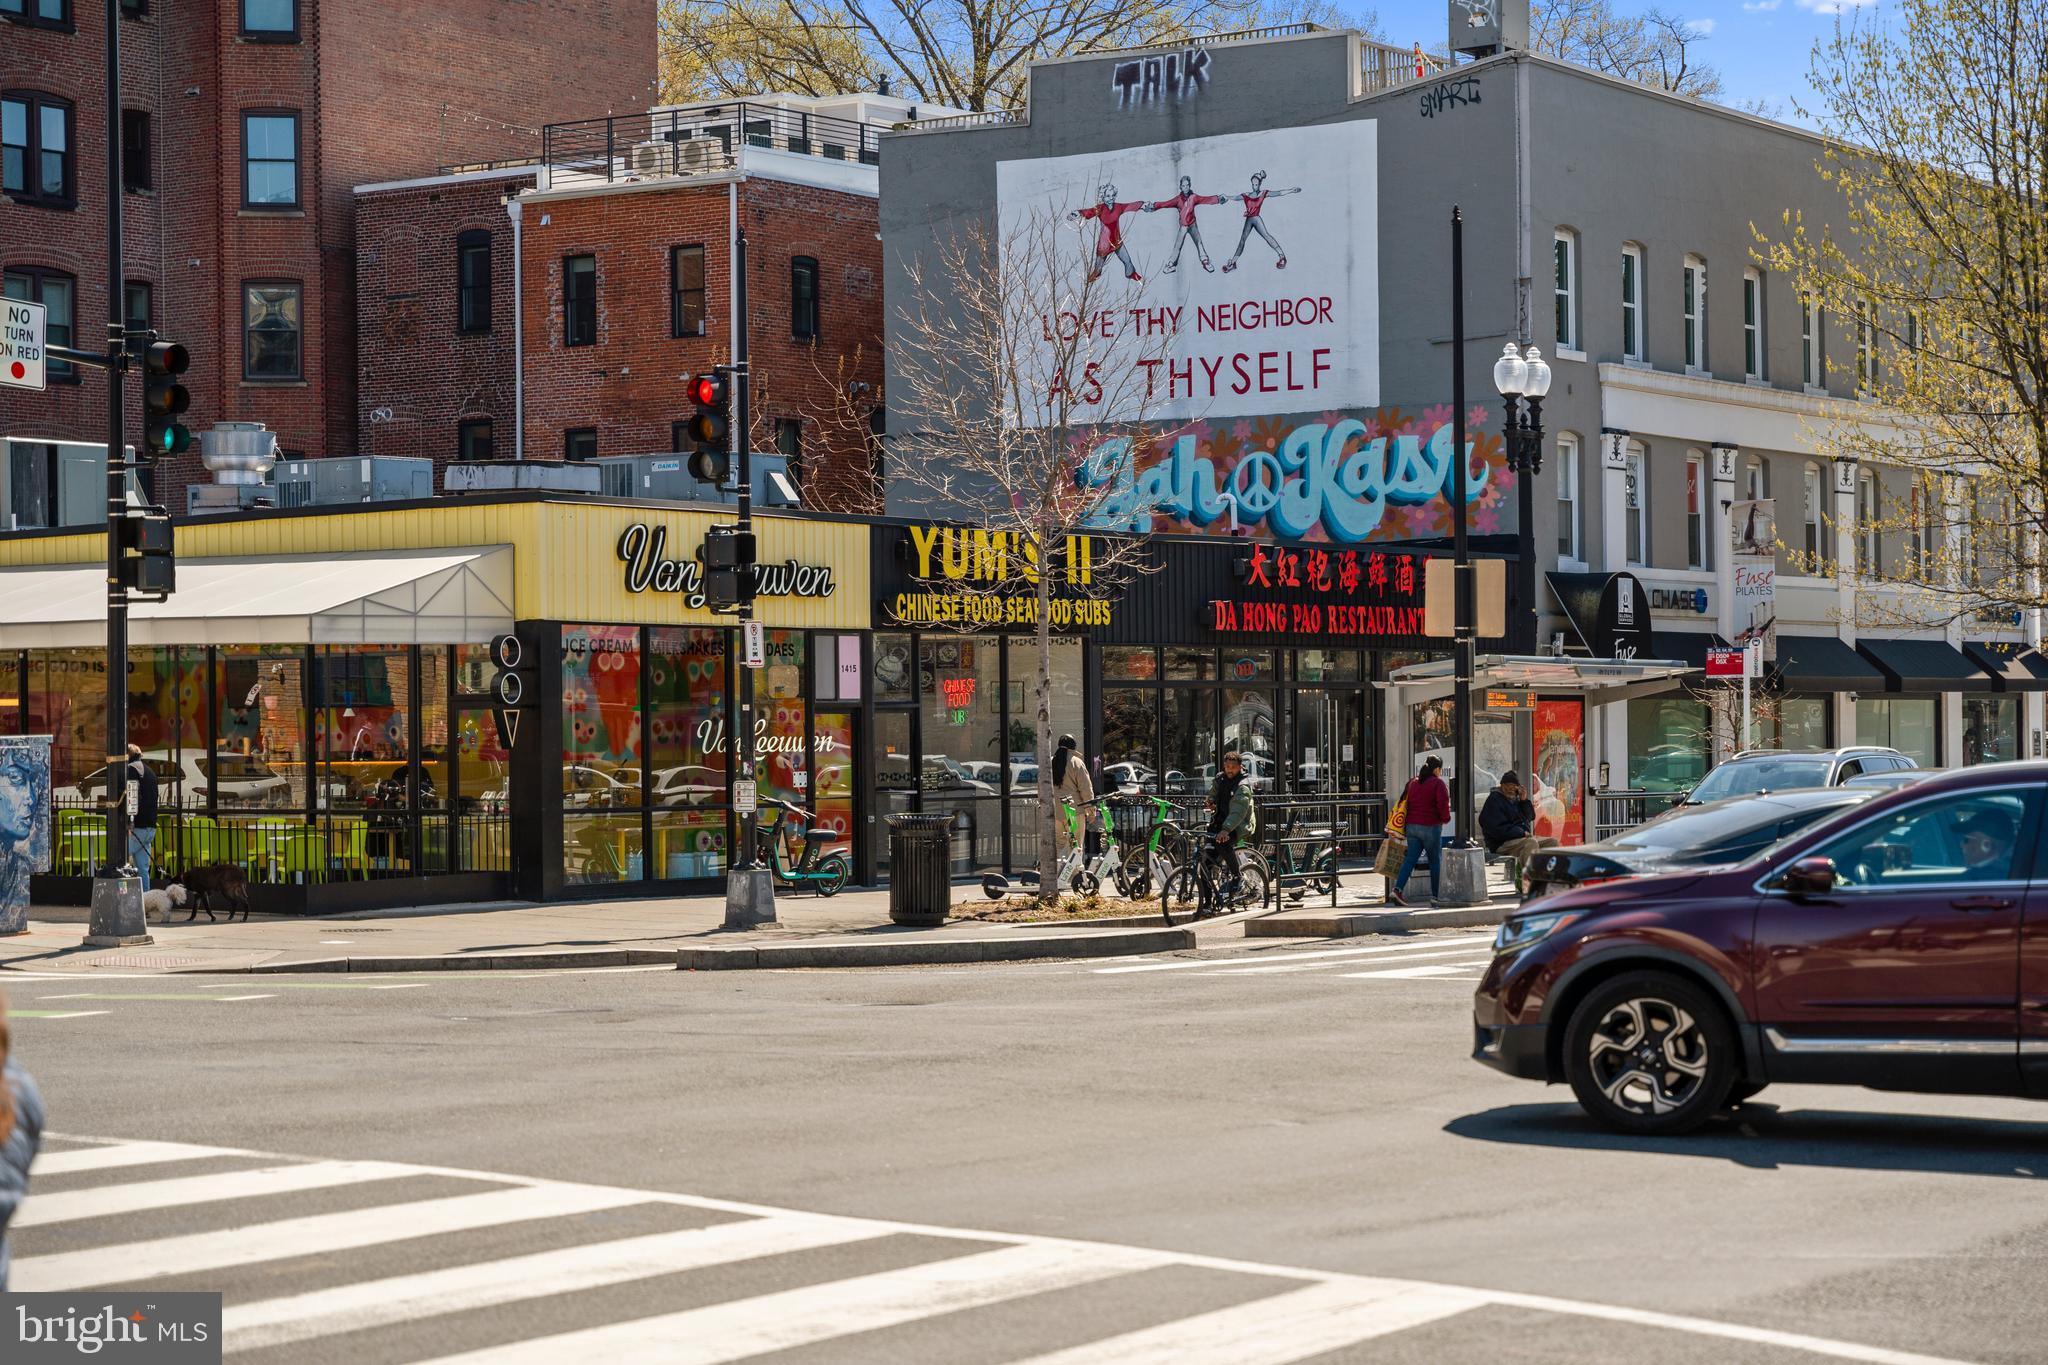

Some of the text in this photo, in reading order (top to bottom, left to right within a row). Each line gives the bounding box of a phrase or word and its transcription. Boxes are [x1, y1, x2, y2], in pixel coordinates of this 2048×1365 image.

[9, 306, 31, 325] NO
[1043, 297, 1334, 342] LOVE THY NEIGHBOR
[5, 326, 34, 343] TURN
[18, 346, 40, 361] RED
[1046, 348, 1332, 406] AS THYSELF
[1735, 567, 1774, 587] Fuse
[1652, 589, 1697, 609] CHASE
[1735, 586, 1773, 596] PILATES
[896, 593, 963, 623] CHINESE
[965, 595, 1003, 624] FOOD
[1075, 600, 1112, 625] SUBS
[1215, 600, 1426, 635] DA HONG PAO RESTAURANT
[563, 639, 634, 654] ICE CREAM
[841, 665, 857, 673] 1415
[943, 678, 976, 694] CHINESE
[948, 692, 972, 706] FOOD
